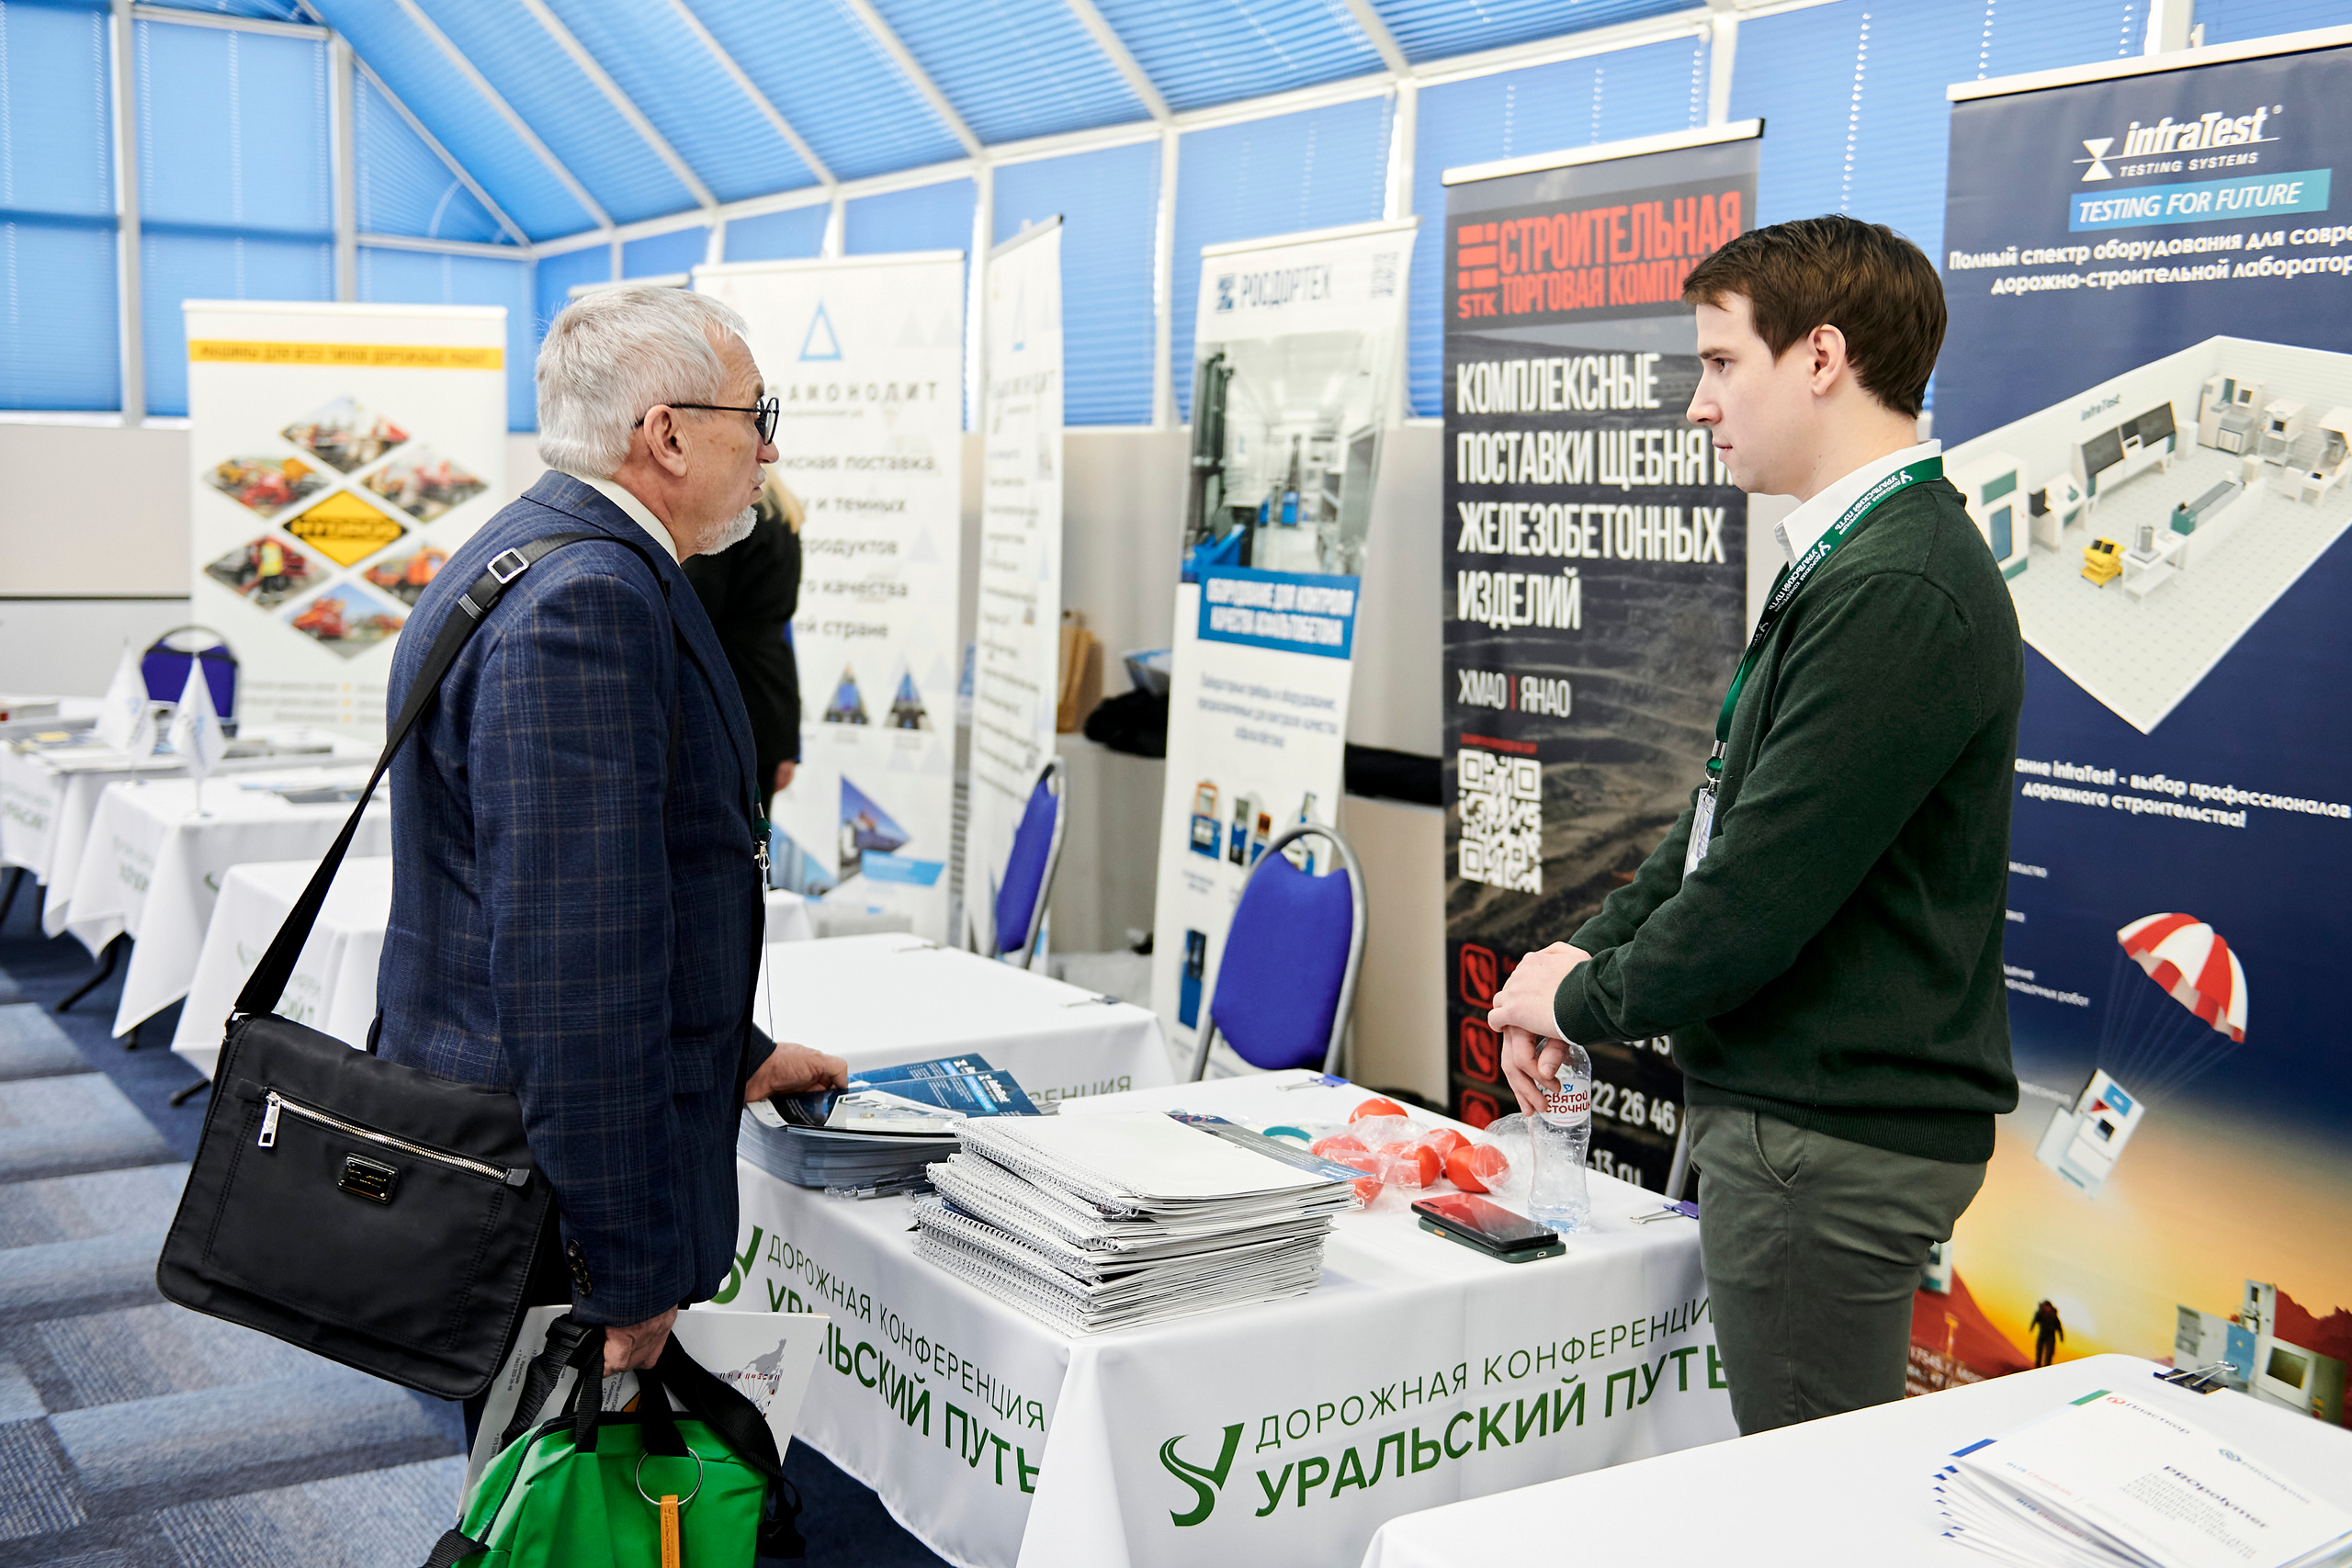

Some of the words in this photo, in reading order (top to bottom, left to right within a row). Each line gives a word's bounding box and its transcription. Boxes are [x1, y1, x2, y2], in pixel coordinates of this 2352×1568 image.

[2122, 107, 2268, 157] infraTest
[2120, 160, 2183, 177] TESTING
[2188, 152, 2259, 172] SYSTEMS
[2079, 194, 2163, 224] TESTING
[2165, 191, 2212, 216] FOR
[2215, 182, 2303, 211] FUTURE
[1499, 191, 1742, 275] СТРОИТЕЛЬНАЯ
[1949, 245, 2018, 270] Полный
[2020, 245, 2091, 265] спектр
[2094, 233, 2244, 262] оборудования
[2245, 231, 2285, 251] для
[1501, 265, 1605, 316] ТОРГОВАЯ
[1609, 257, 1702, 307] КОМПА
[1990, 258, 2230, 296] дорожно-строительной
[2232, 254, 2352, 279] лаборатор
[1457, 353, 1661, 414] КОМПЛЕКСНЫЕ
[1457, 431, 1592, 485] ПОСТАВКИ
[1598, 429, 1708, 491] ЩЕБНЯ
[1852, 475, 1898, 512] УРАЛЬСКИЙ
[1457, 502, 1726, 564] ЖЕЛЕЗОБЕТОННЫХ
[1834, 510, 1854, 530] ПУТЬ
[1782, 548, 1818, 592] УРАЛЬСКИЙ
[1457, 566, 1582, 631] ИЗДЕЛИЙ
[1769, 591, 1786, 610] ПУТЬ
[1458, 669, 1508, 710] ХМАО
[1520, 676, 1571, 717] ЯНАО
[2021, 781, 2109, 808] дорожного
[2111, 795, 2247, 828] строительства!
[2130, 773, 2188, 798] выбор
[2188, 783, 2352, 818] профессионалов
[1544, 1090, 1589, 1104] СВЯТОЙ
[1591, 1079, 1616, 1117] 22
[1620, 1088, 1645, 1126] 26
[1649, 1098, 1676, 1135] 46
[767, 1235, 872, 1324] ДОРОЖНАЯ
[879, 1303, 1046, 1432] КОНФЕРЕНЦИЯ
[766, 1278, 931, 1437] УРЛЬСКИЙ
[945, 1401, 1040, 1495] ПУТЬ
[1256, 1362, 1467, 1453] ДОРОЖНАЯ
[1255, 1374, 1586, 1517] УРАЛЬСКИЙ
[1604, 1345, 1728, 1418] ПУТЬ
[2124, 1402, 2191, 1436] Пласткор
[2163, 1465, 2269, 1529] PROpolymer
